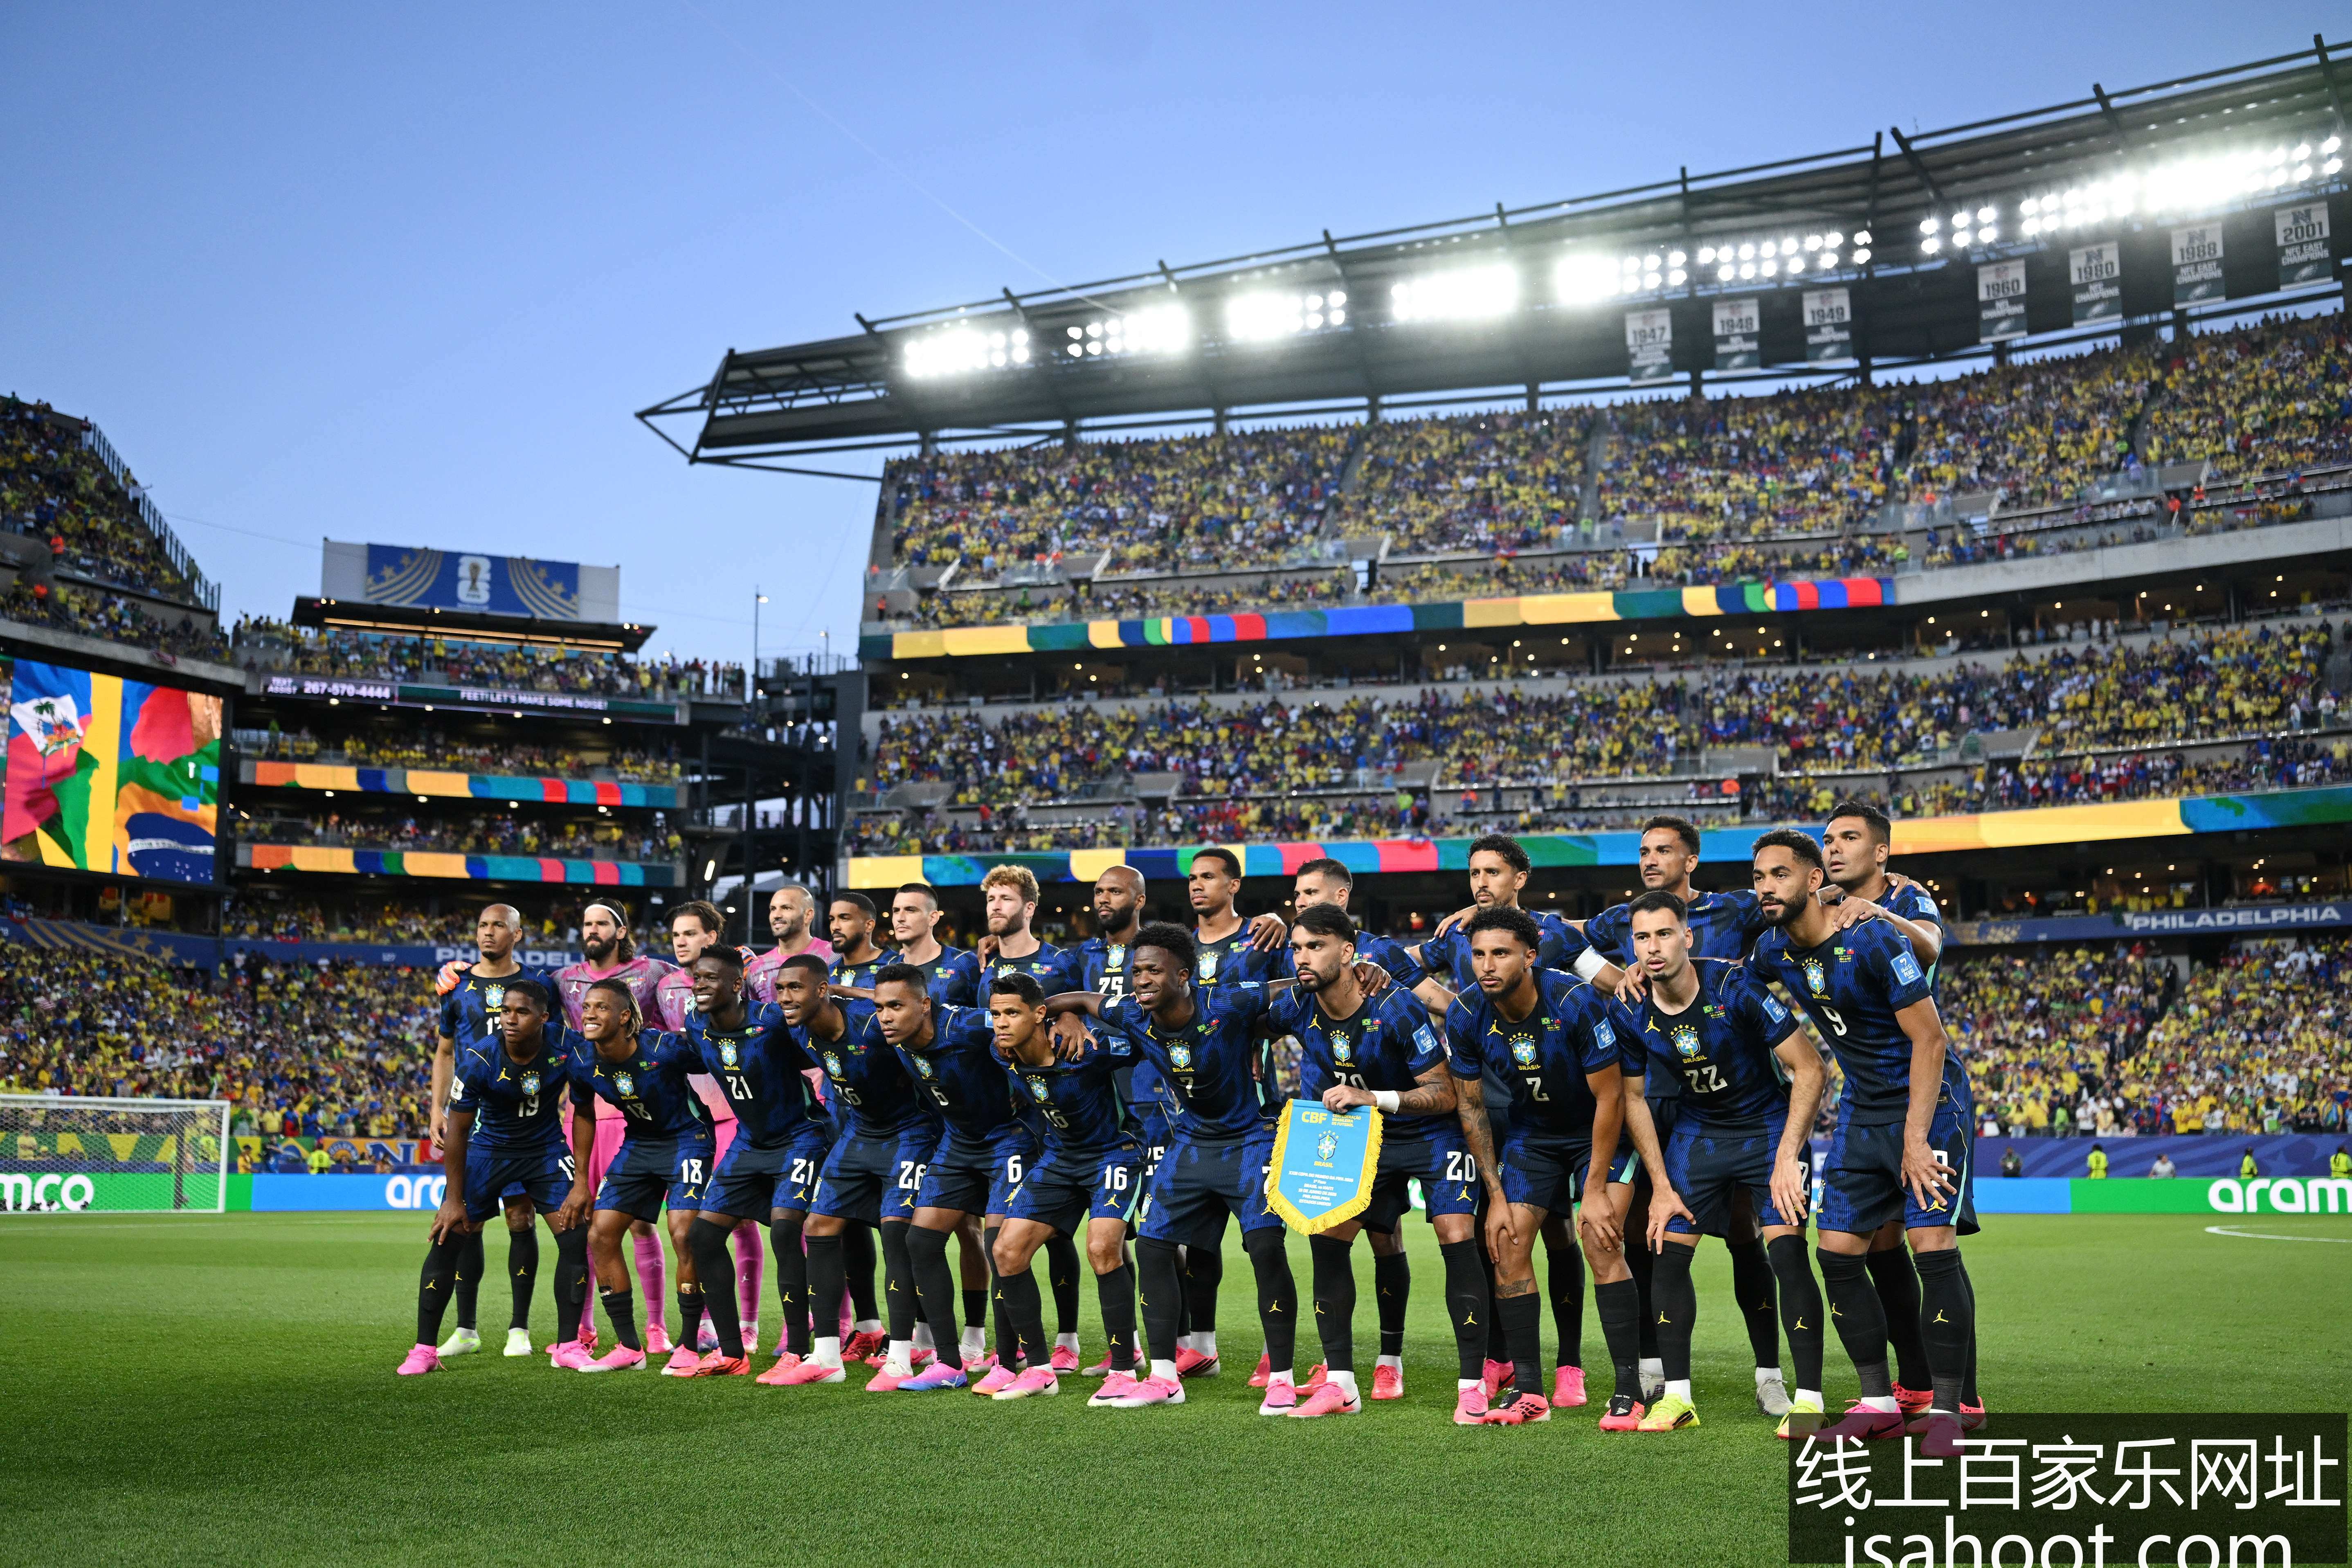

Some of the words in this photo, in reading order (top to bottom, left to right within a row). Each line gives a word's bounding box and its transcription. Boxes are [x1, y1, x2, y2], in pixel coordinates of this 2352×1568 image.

[2283, 222, 2324, 243] 2001
[2180, 241, 2217, 261] 1988
[2281, 247, 2330, 266] CHAMPIONS
[2303, 241, 2324, 254] EAST
[2077, 261, 2115, 283] 1980
[2176, 267, 2222, 285] CHAMPIONS
[2197, 260, 2217, 273] EAST
[1985, 279, 2020, 298] 1960
[2075, 286, 2120, 304] CHAMPIONS
[1720, 316, 1754, 333] 1948
[1810, 306, 1845, 324] 1949
[1631, 326, 1666, 343] 1947
[304, 681, 391, 700] 267-570-4444
[518, 693, 546, 706] MAKE
[547, 695, 573, 708] SOME
[2132, 905, 2341, 931] PHILADELPHIA
[1821, 1006, 1847, 1036] 9
[1682, 1055, 1708, 1064] BRASIL
[725, 1075, 753, 1100] 21
[1179, 1076, 1194, 1098] 7
[1683, 1064, 1728, 1093] 22
[931, 1086, 949, 1106] 6
[1526, 1077, 1550, 1102] 2
[518, 1095, 540, 1118] 19
[626, 1102, 653, 1121] 18
[1042, 1108, 1069, 1128] 16
[1302, 1111, 1328, 1124] CBF
[681, 1158, 703, 1185] 18
[790, 1158, 815, 1186] 21
[1007, 1155, 1022, 1183] 6
[1446, 1151, 1475, 1182] 20
[1104, 1165, 1127, 1191] 16
